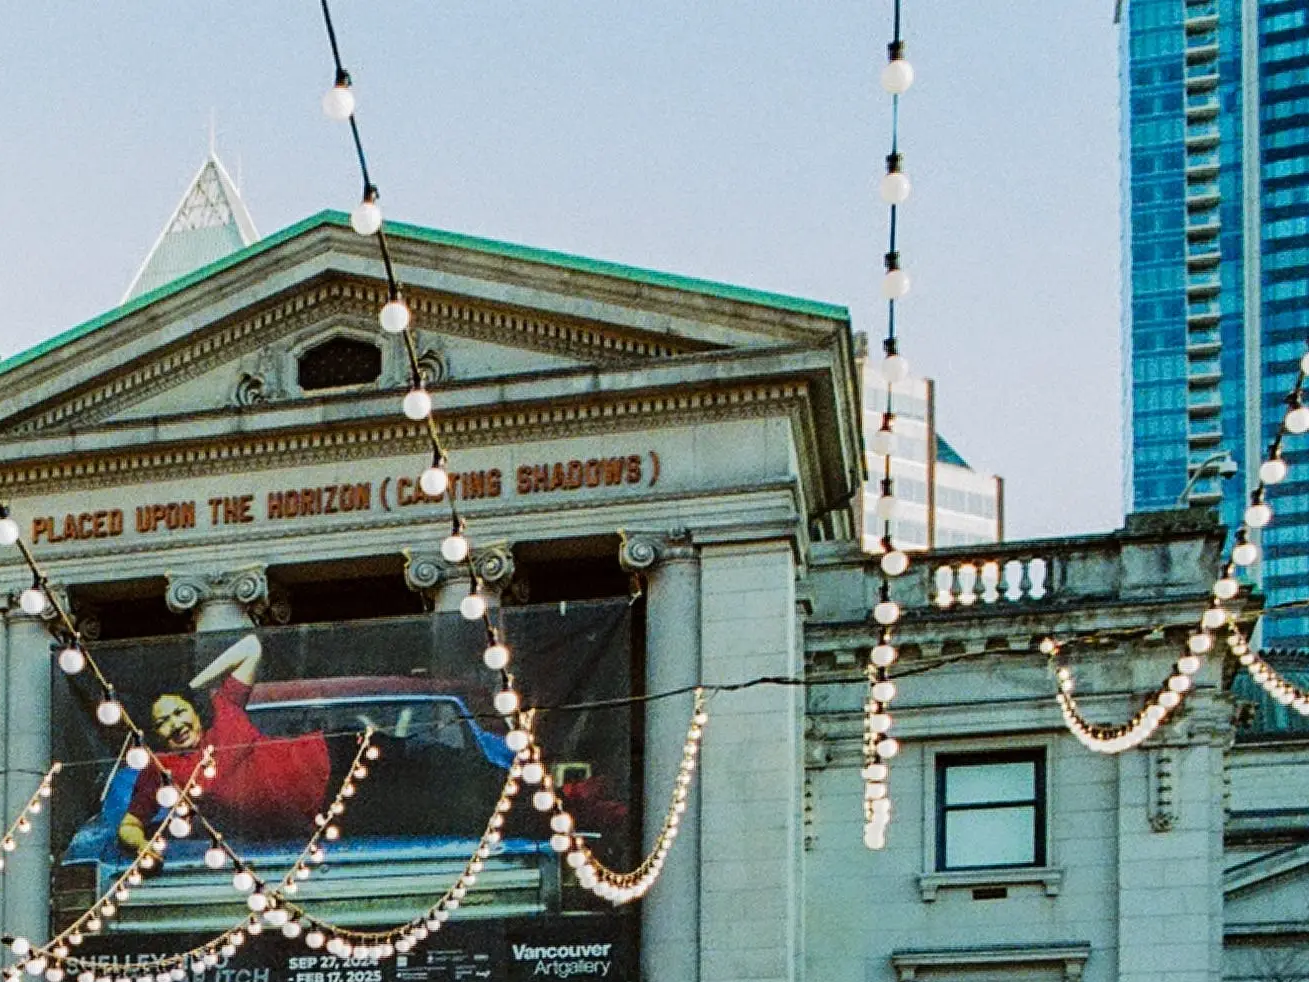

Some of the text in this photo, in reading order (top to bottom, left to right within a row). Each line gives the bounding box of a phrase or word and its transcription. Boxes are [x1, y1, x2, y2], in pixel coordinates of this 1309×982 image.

[31, 508, 123, 544] PLACED
[135, 500, 196, 533] UPON
[208, 494, 254, 525] THE
[266, 481, 372, 520] HORIZON
[512, 943, 612, 960] Vancouver
[288, 956, 318, 970] SEP
[534, 959, 611, 978] Artgallery
